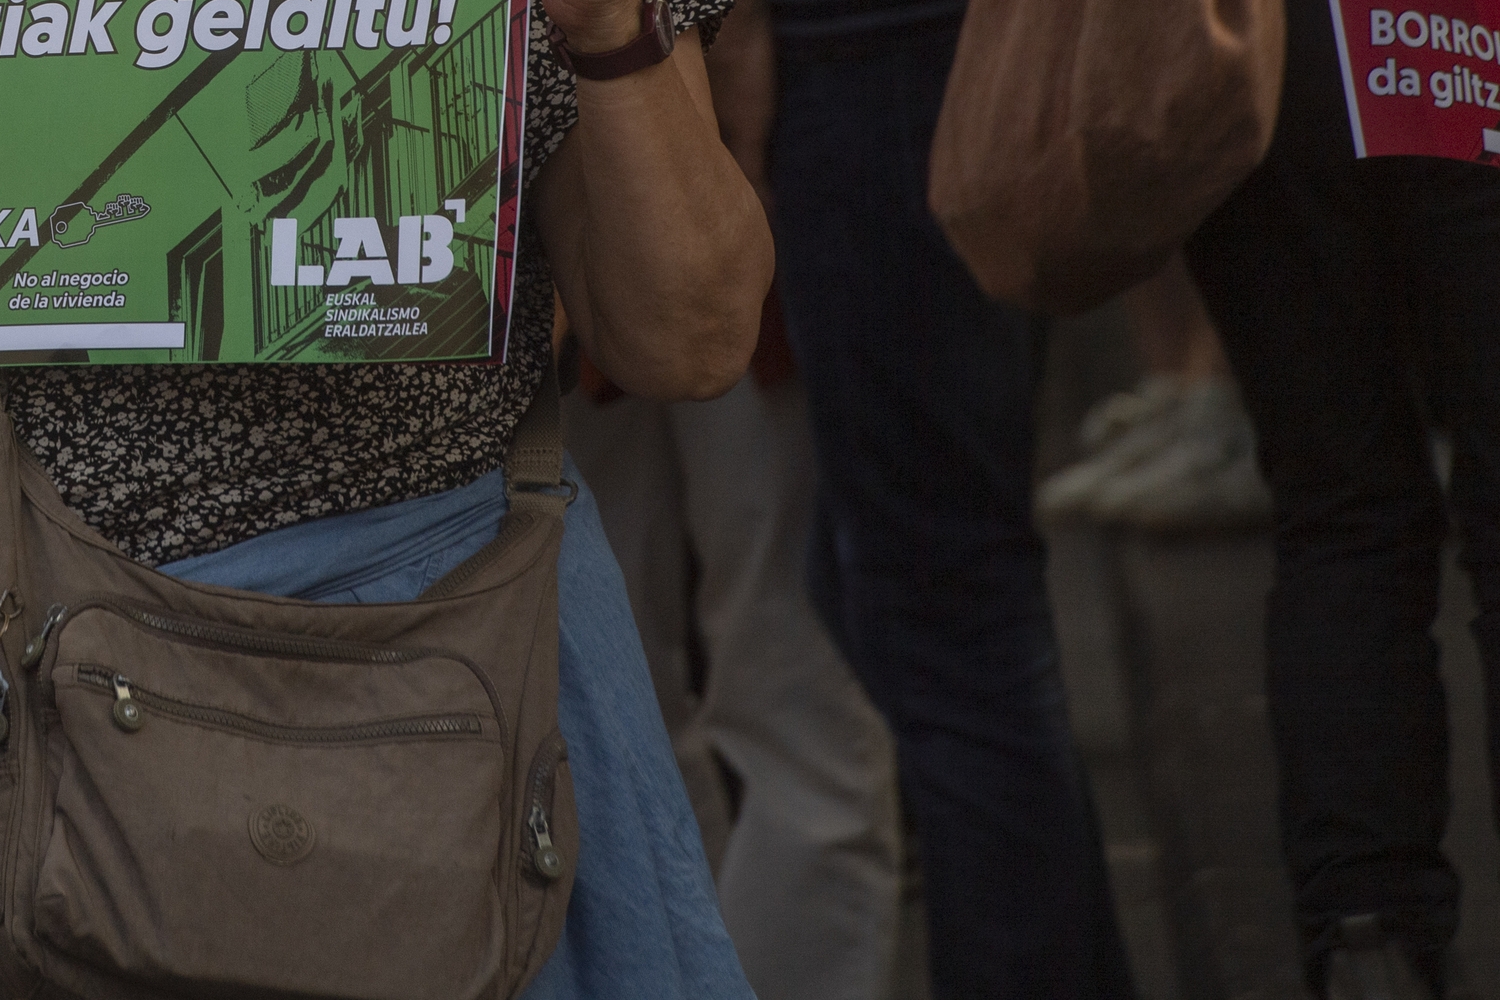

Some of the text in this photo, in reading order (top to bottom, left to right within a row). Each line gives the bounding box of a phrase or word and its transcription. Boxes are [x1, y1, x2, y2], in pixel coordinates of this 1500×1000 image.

[1367, 57, 1422, 97] da
[270, 212, 456, 287] LAB
[13, 268, 130, 290] No al negocio
[8, 290, 126, 310] de la vivienda
[324, 292, 377, 307] EUSKAL
[324, 306, 421, 323] SINDIKALISMO
[323, 321, 429, 338] ERALDATZAILEA
